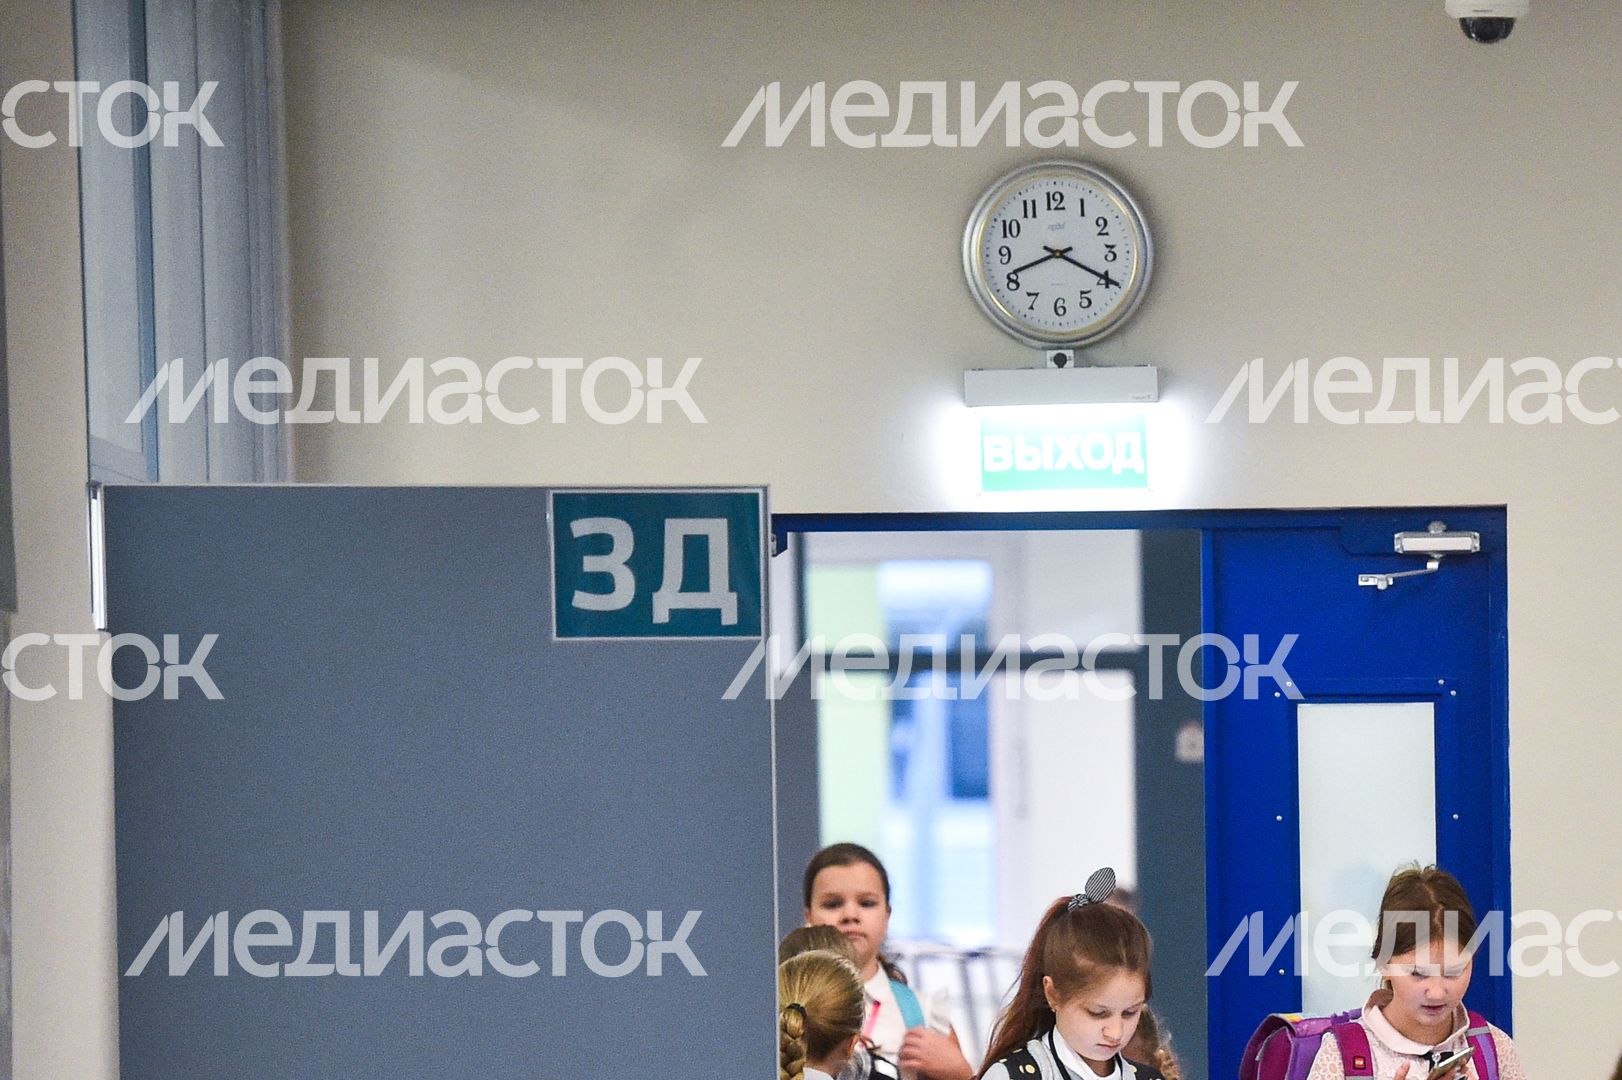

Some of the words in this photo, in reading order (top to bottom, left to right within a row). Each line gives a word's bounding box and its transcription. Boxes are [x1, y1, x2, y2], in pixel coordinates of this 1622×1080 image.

[1023, 199, 1037, 219] 11
[1046, 191, 1066, 211] 12
[1080, 198, 1085, 217] 1
[1002, 219, 1021, 239] 10
[1095, 216, 1109, 236] 2
[998, 245, 1012, 265] 9
[1104, 244, 1117, 262] 3
[1006, 271, 1020, 291] 8
[1026, 292, 1039, 310] 7
[1053, 297, 1067, 317] 6
[1079, 289, 1092, 309] 5
[983, 431, 1145, 475] ВЫХОД
